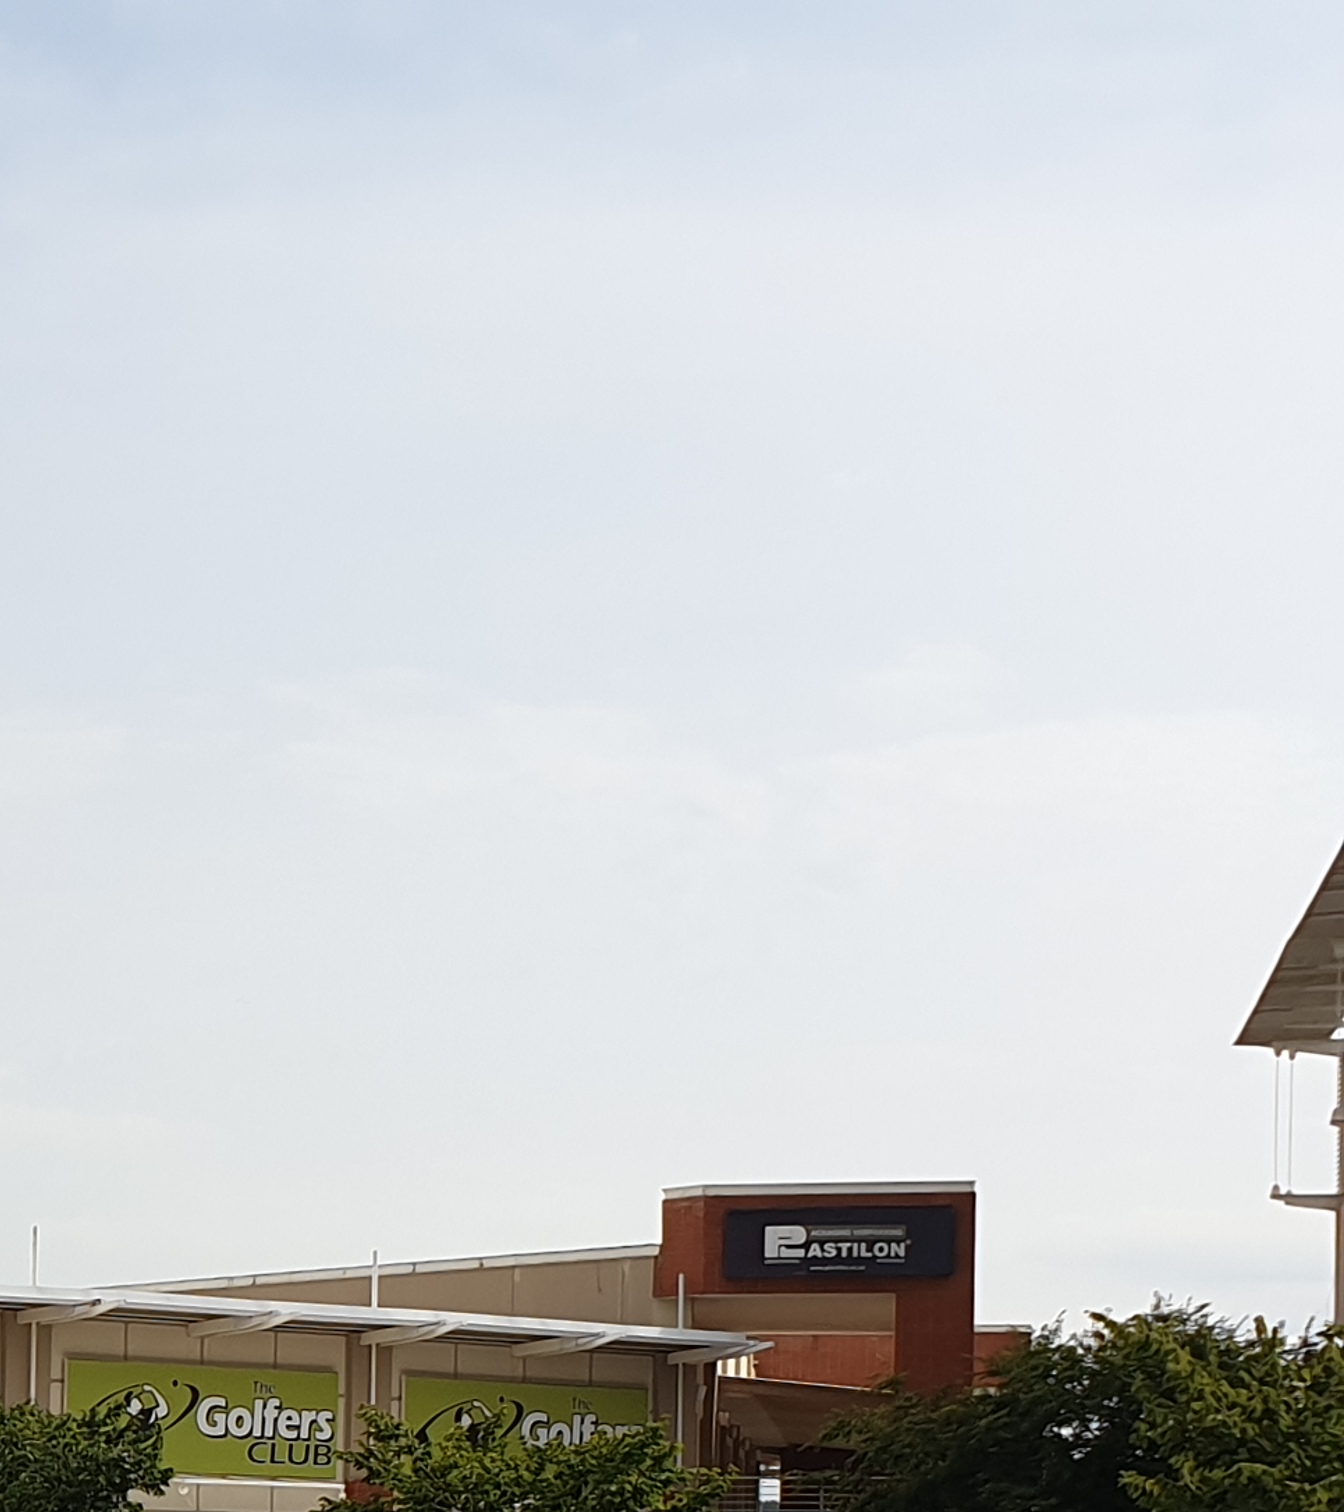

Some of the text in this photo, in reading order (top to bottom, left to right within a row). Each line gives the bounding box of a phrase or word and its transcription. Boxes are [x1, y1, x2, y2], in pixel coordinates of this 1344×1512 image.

[254, 1380, 276, 1395] The
[196, 1396, 334, 1441] Golfers
[247, 1441, 332, 1465] CLUB
